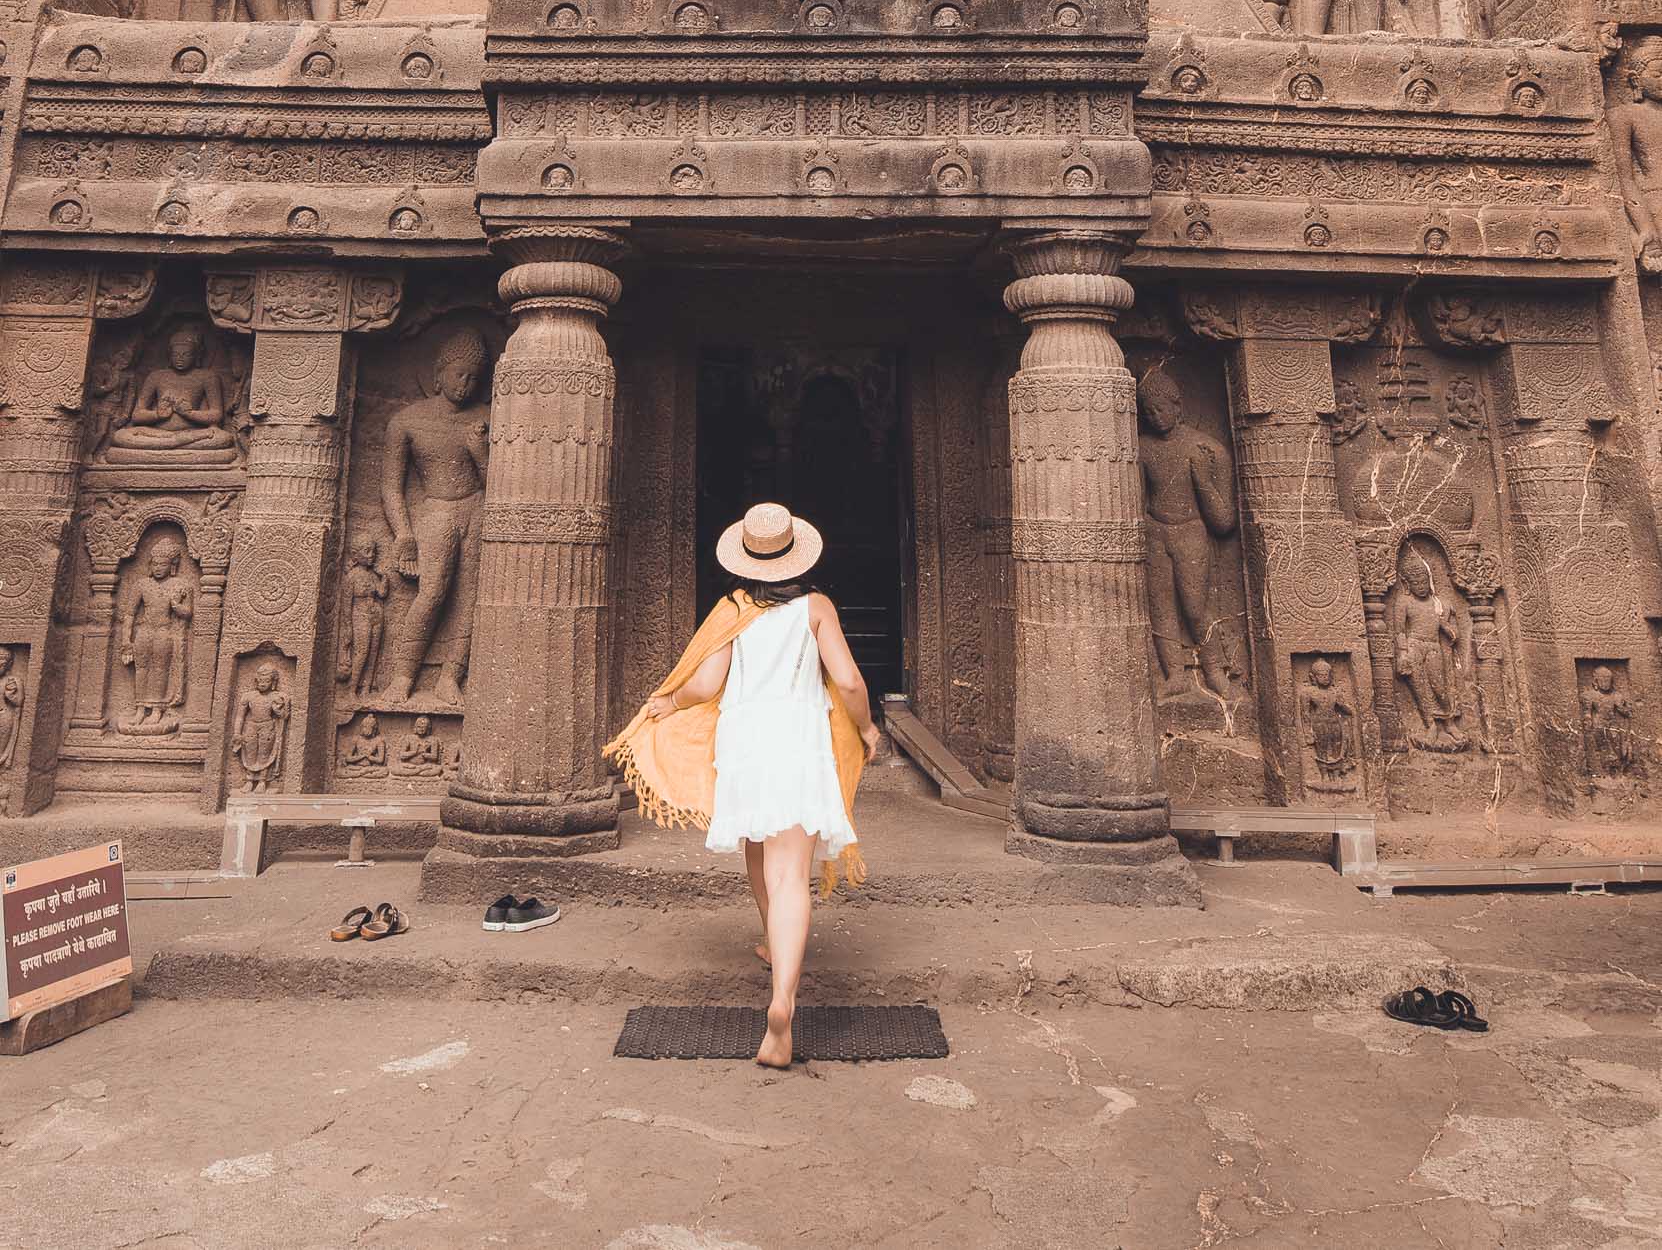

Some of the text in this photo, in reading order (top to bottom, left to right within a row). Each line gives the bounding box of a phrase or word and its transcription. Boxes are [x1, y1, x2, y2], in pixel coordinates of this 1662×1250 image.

[24, 898, 46, 921] कृपया
[12, 903, 120, 947] PLEASE REMOVE FOOT WEAR HERE
[19, 954, 43, 978] कृपया
